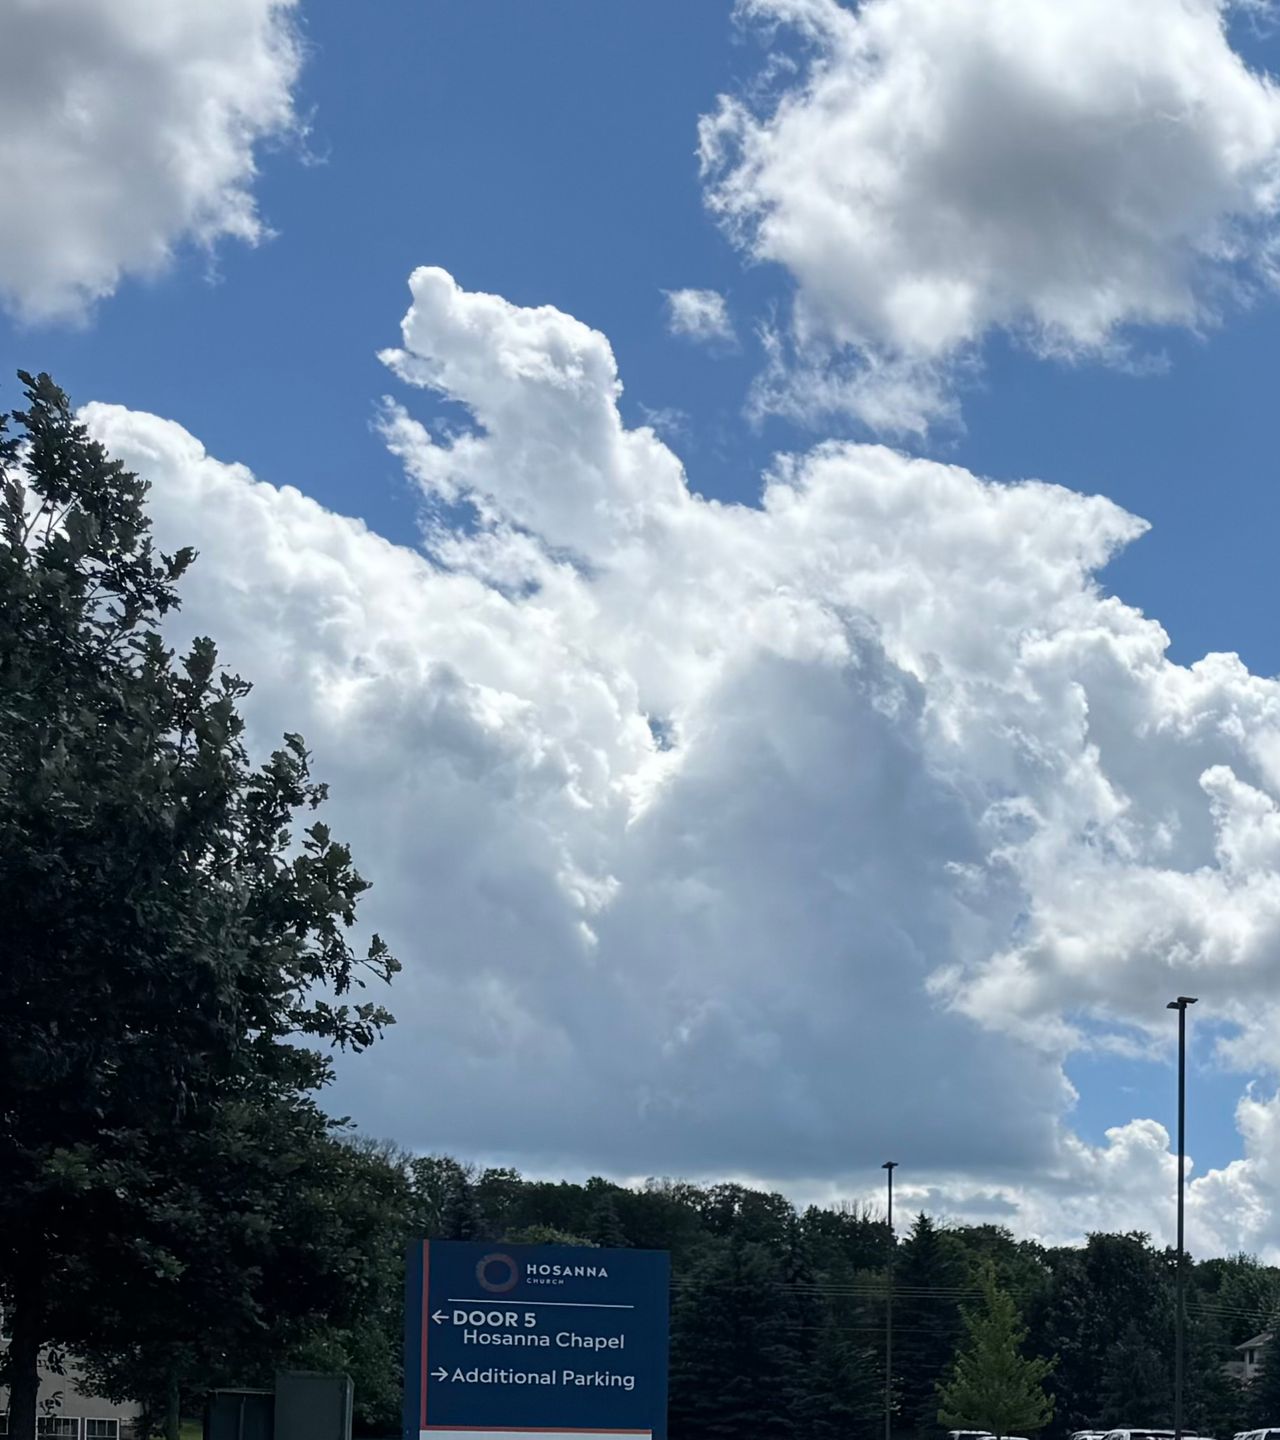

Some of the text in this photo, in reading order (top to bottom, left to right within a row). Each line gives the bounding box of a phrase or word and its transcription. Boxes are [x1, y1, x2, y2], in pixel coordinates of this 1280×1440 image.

[526, 1263, 608, 1278] HOSANNA
[526, 1277, 564, 1285] CHURCH
[453, 1310, 537, 1328] DOOR 5
[463, 1329, 625, 1352] Hosanna Chapel
[451, 1367, 635, 1391] Additional Parking
